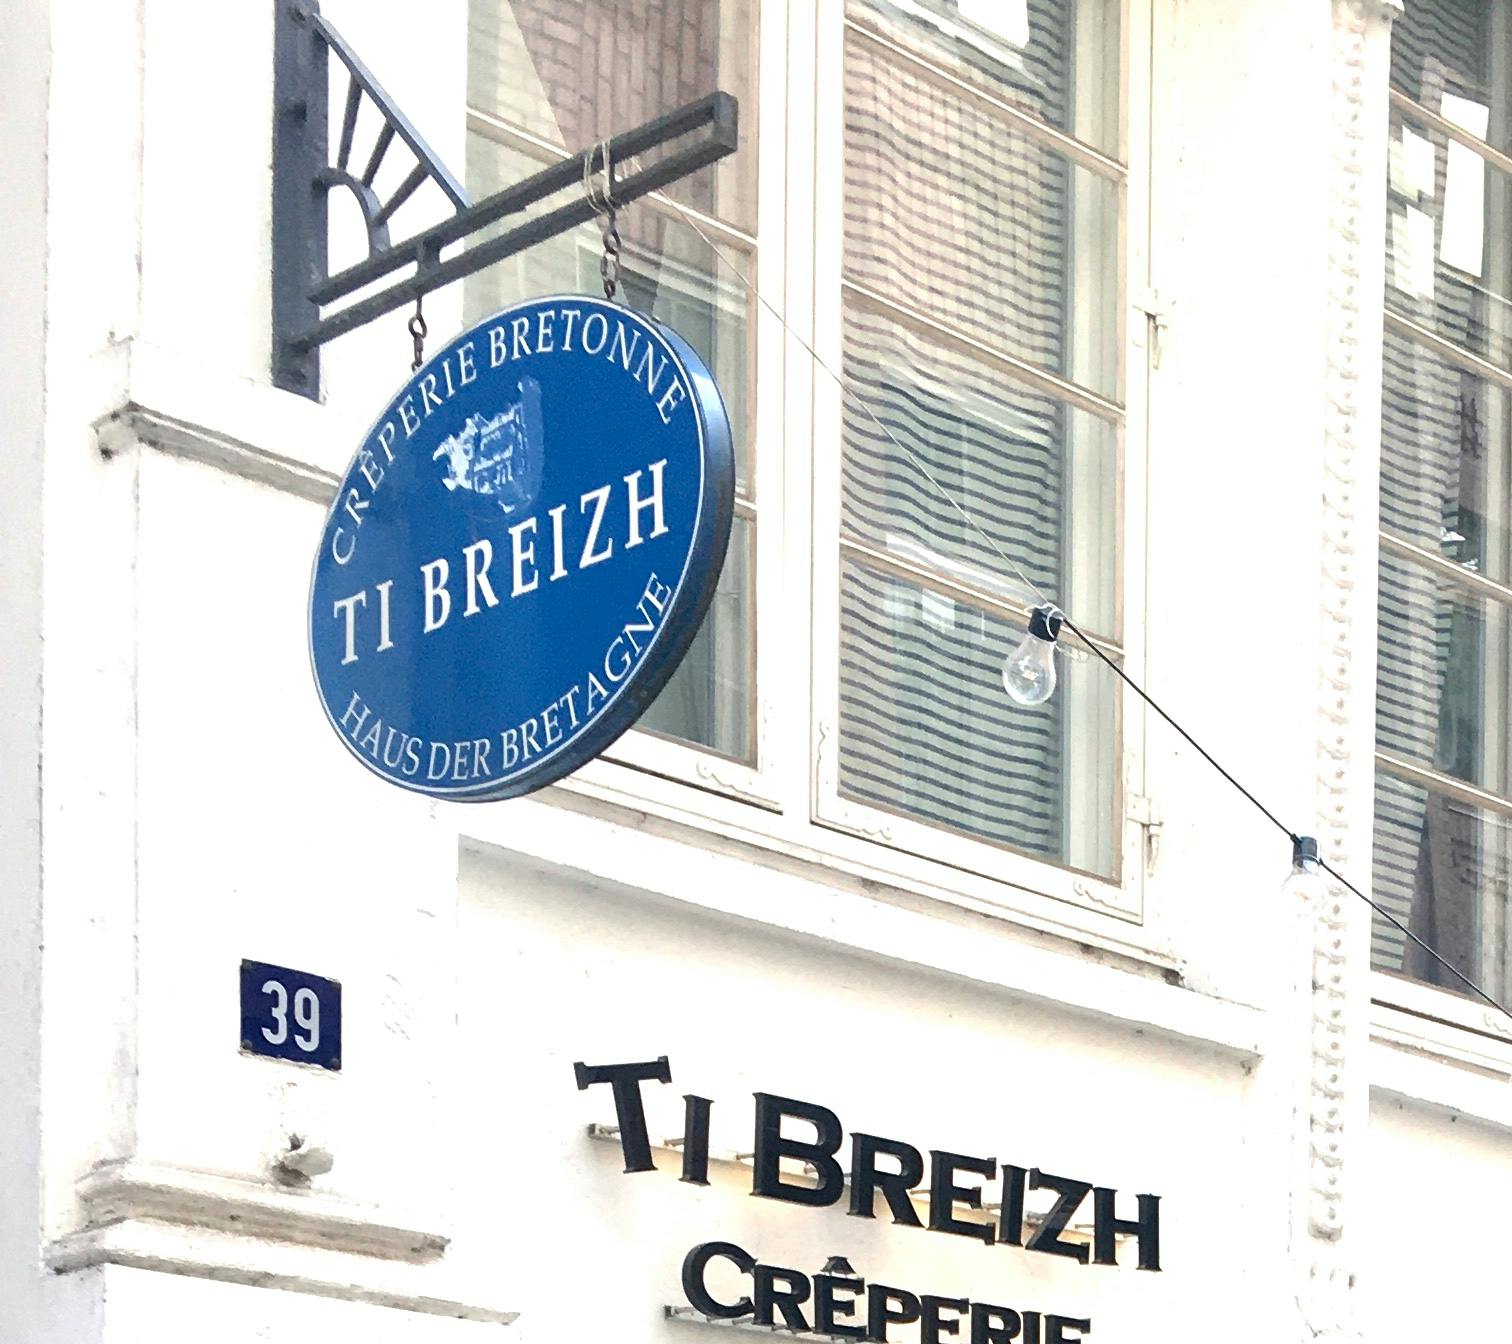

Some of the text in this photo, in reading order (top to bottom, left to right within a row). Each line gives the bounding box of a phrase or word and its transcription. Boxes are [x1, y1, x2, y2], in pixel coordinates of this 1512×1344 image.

[332, 309, 685, 566] CRÊPERIE BRETONNE
[334, 459, 669, 665] TI BREIZH
[339, 572, 673, 781] HAUS DER BRETAGNE
[261, 980, 321, 1052] 39
